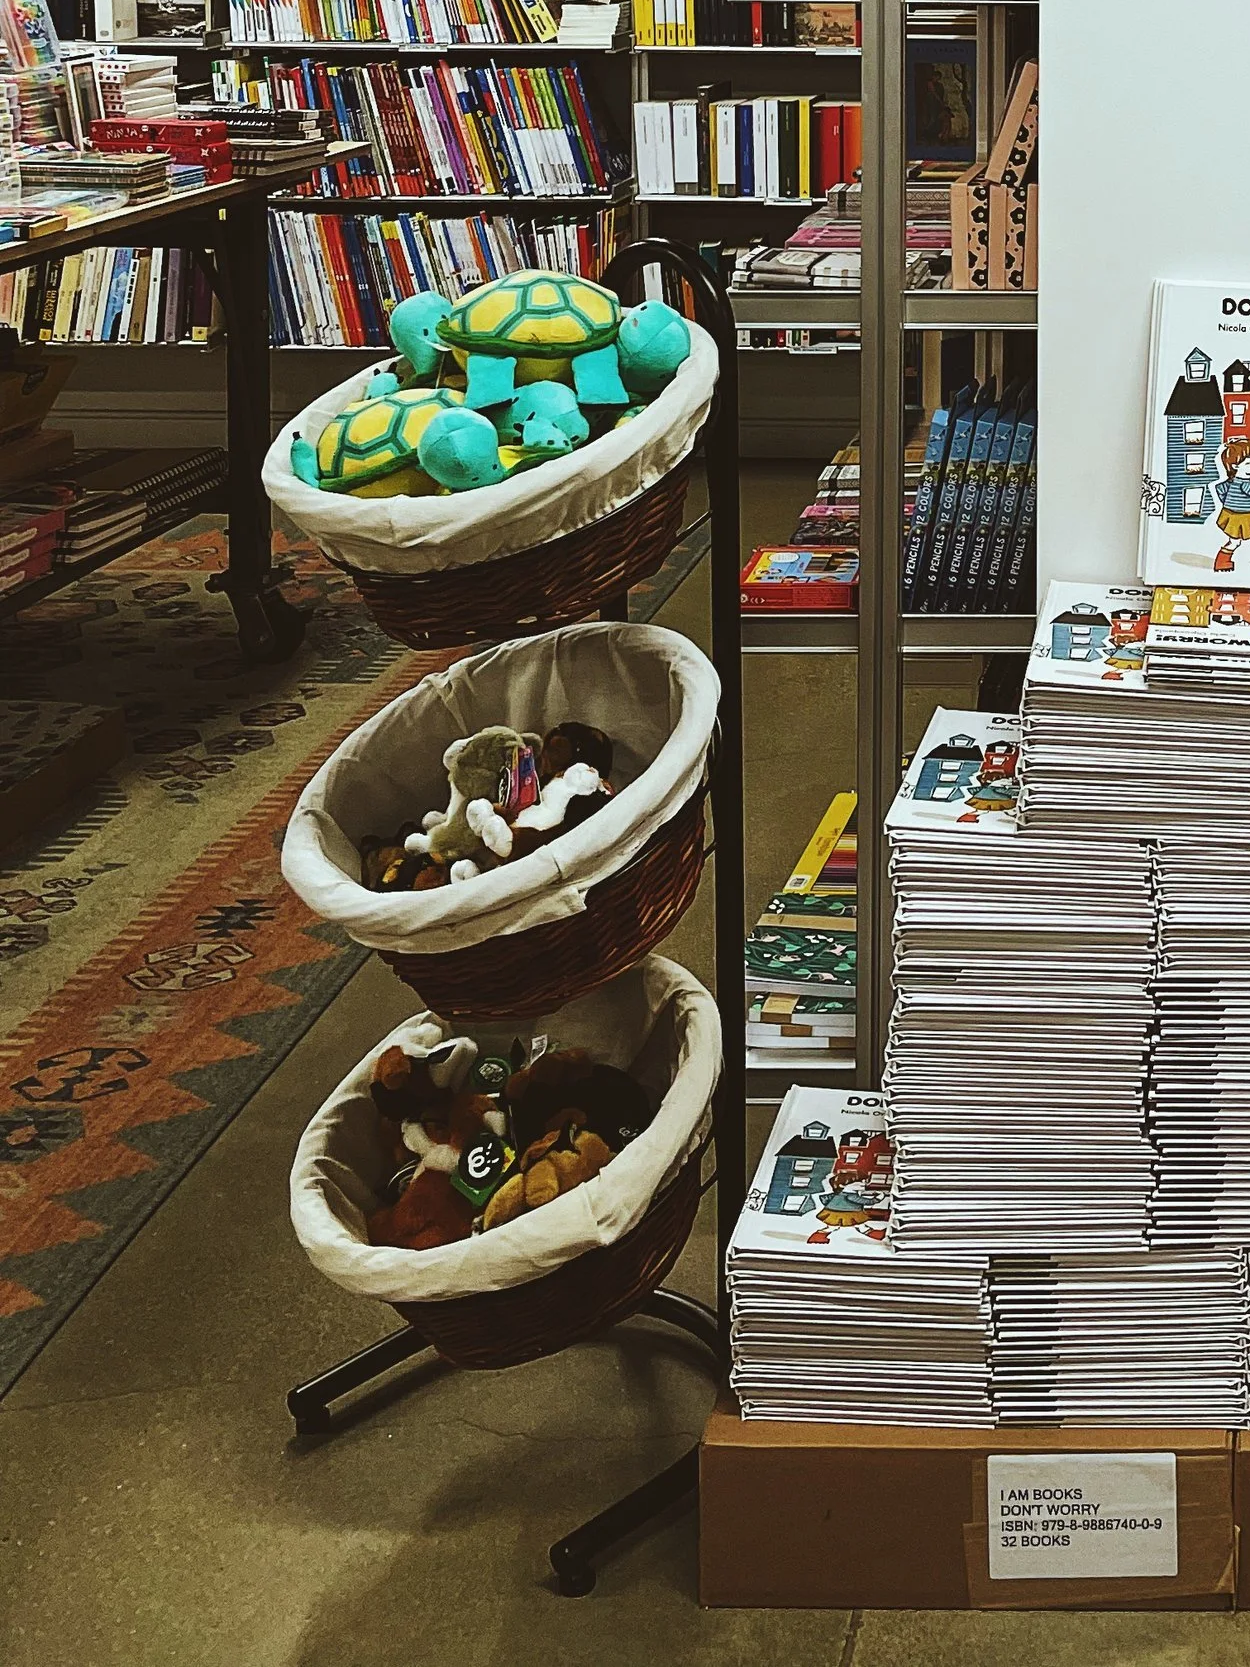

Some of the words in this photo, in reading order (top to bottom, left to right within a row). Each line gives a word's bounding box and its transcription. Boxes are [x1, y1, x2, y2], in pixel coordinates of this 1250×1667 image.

[1218, 323, 1246, 333] Nicola
[918, 475, 934, 512] COLORS
[943, 472, 958, 510] COLORS
[964, 473, 979, 511] COLORS
[983, 475, 999, 512] COLORS
[1004, 476, 1019, 513] COLORS
[915, 514, 926, 526] 12
[940, 511, 950, 523] 12
[961, 512, 971, 524] 12
[980, 514, 990, 525] 12
[1000, 515, 1010, 526] 12
[905, 536, 921, 575] PENCILS
[930, 533, 945, 573] PENCILS
[950, 534, 966, 574] PENCILS
[969, 536, 985, 575] PENCILS
[989, 537, 1006, 576] PENCILS
[1011, 536, 1027, 576] PENCILS
[1021, 515, 1032, 526] 12
[1109, 587, 1153, 598] DON
[1000, 1490, 1004, 1501] I
[1008, 1489, 1029, 1501] AM
[1033, 1489, 1083, 1500] BOOKS
[1001, 1504, 1043, 1516] DON'T
[1047, 1503, 1101, 1516] WORRY
[1001, 1520, 1038, 1532] ISBN:
[1041, 1517, 1163, 1531] 979-8-9886740-0-9
[1001, 1536, 1017, 1547] 32
[1021, 1534, 1071, 1547] BOOKS
